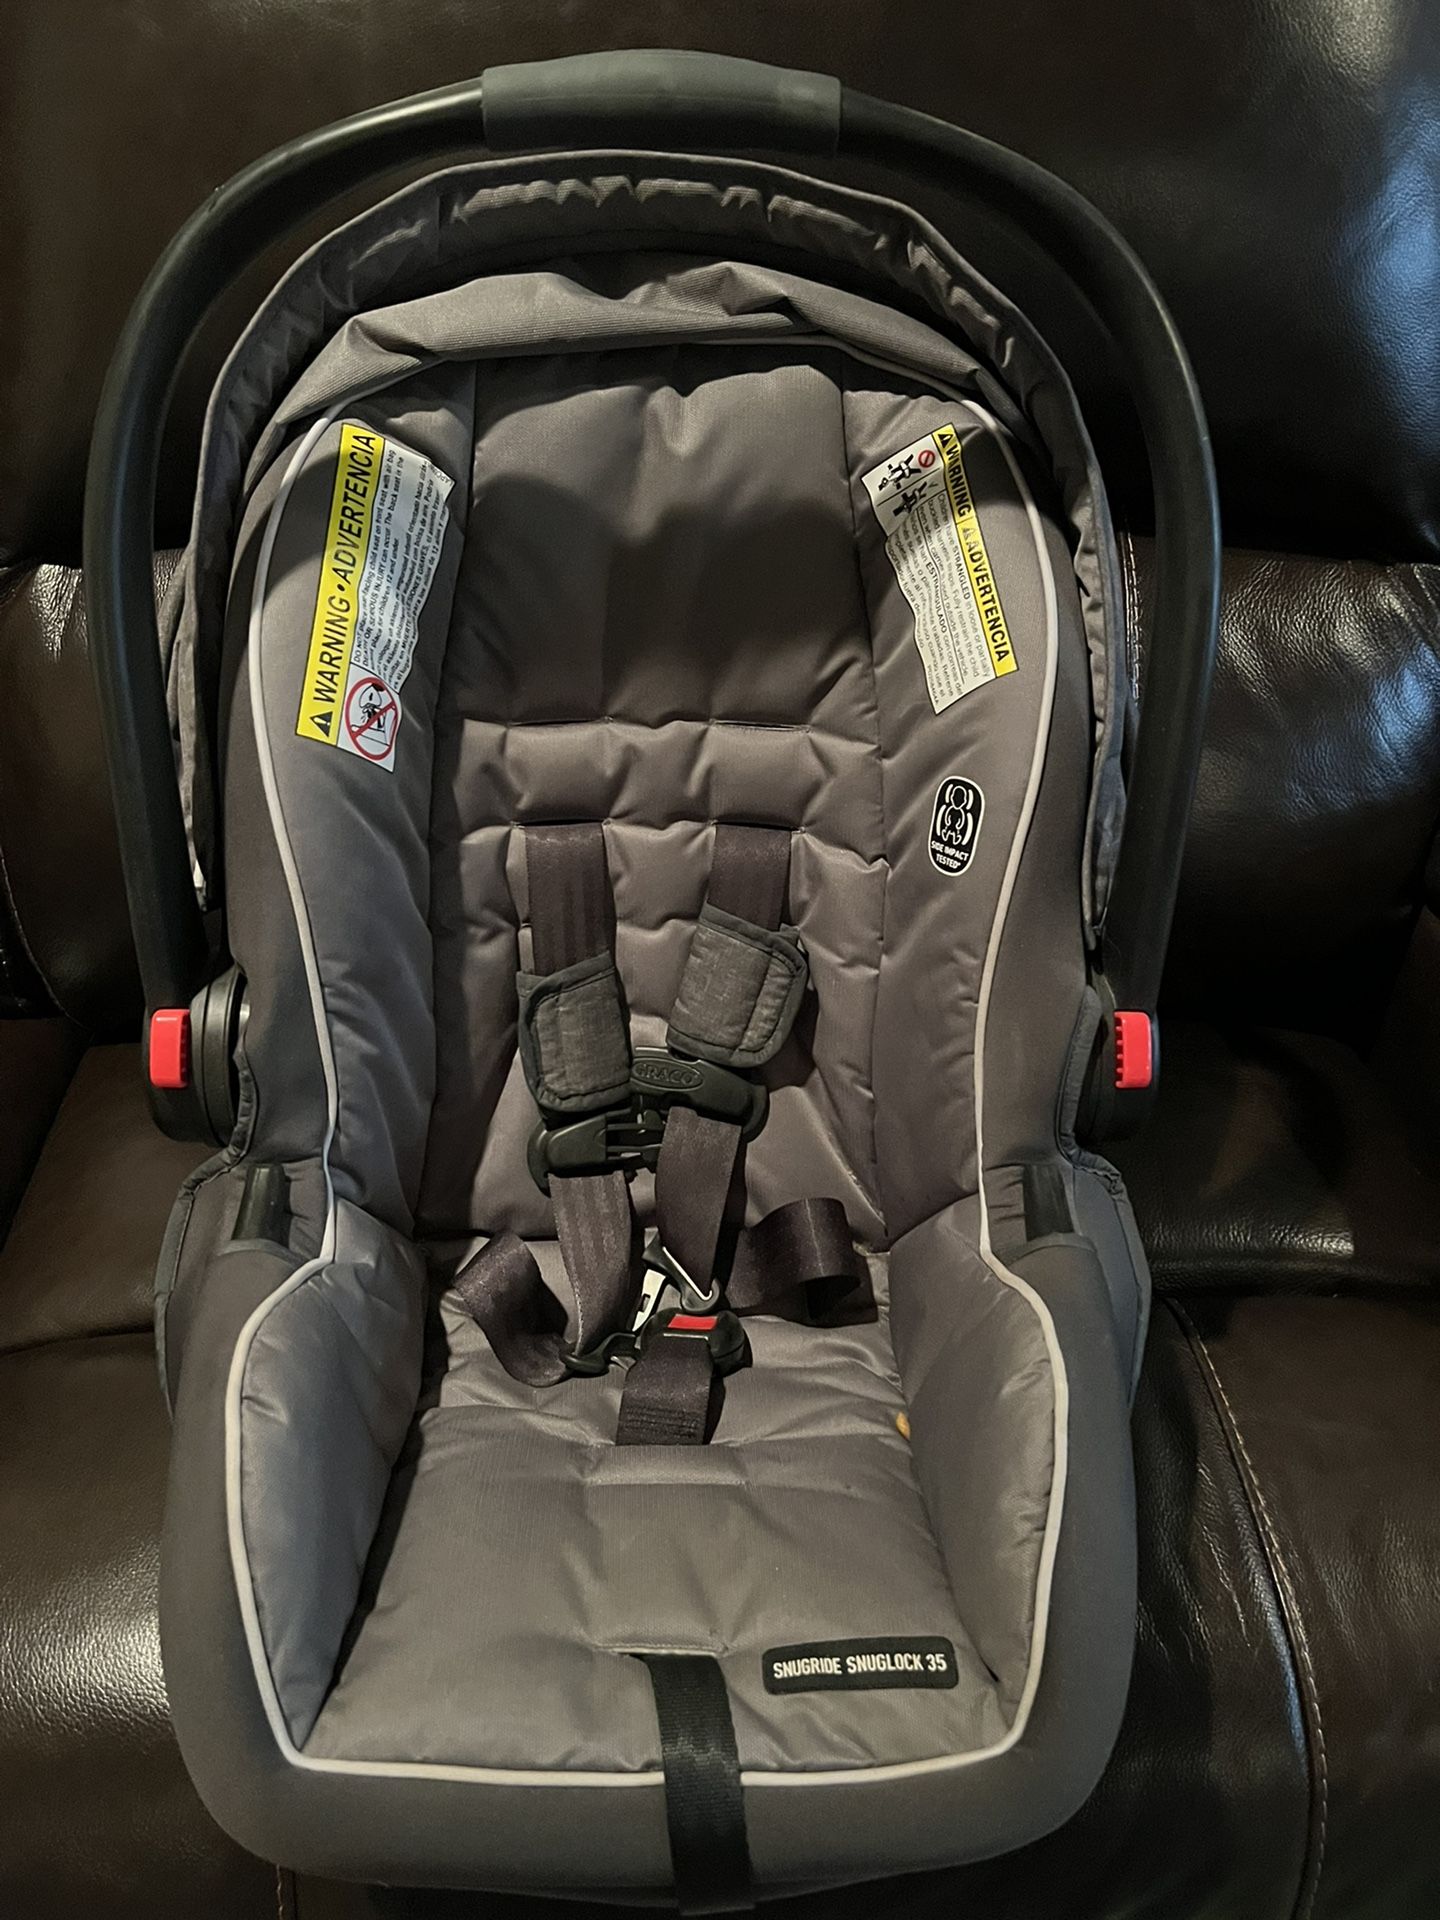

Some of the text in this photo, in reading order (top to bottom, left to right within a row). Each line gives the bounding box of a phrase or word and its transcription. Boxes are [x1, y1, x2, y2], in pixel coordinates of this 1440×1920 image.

[387, 449, 395, 462] bag
[946, 444, 971, 517] WARNING
[313, 434, 375, 703] WARNING ADVERTENCIA
[374, 561, 385, 591] INJURY
[388, 493, 397, 511] back
[372, 628, 382, 647] place
[379, 585, 390, 615] children
[903, 582, 915, 602] fuera
[919, 545, 927, 562] han
[926, 561, 947, 633] ESTRANGULADO
[948, 651, 958, 681] correas
[938, 493, 950, 525] Children
[953, 545, 970, 599] STRANGLED
[968, 610, 978, 633] loose
[977, 644, 990, 677] partially
[966, 537, 1010, 662] ADVERTENCIA
[402, 618, 412, 649] MUERTE
[951, 588, 961, 609] Fully
[958, 610, 969, 641] restrain
[970, 656, 979, 677] child
[931, 841, 969, 861] SIDE IMPACT
[773, 1652, 947, 1679] SNUGRIDE SNUGLOCK 35
